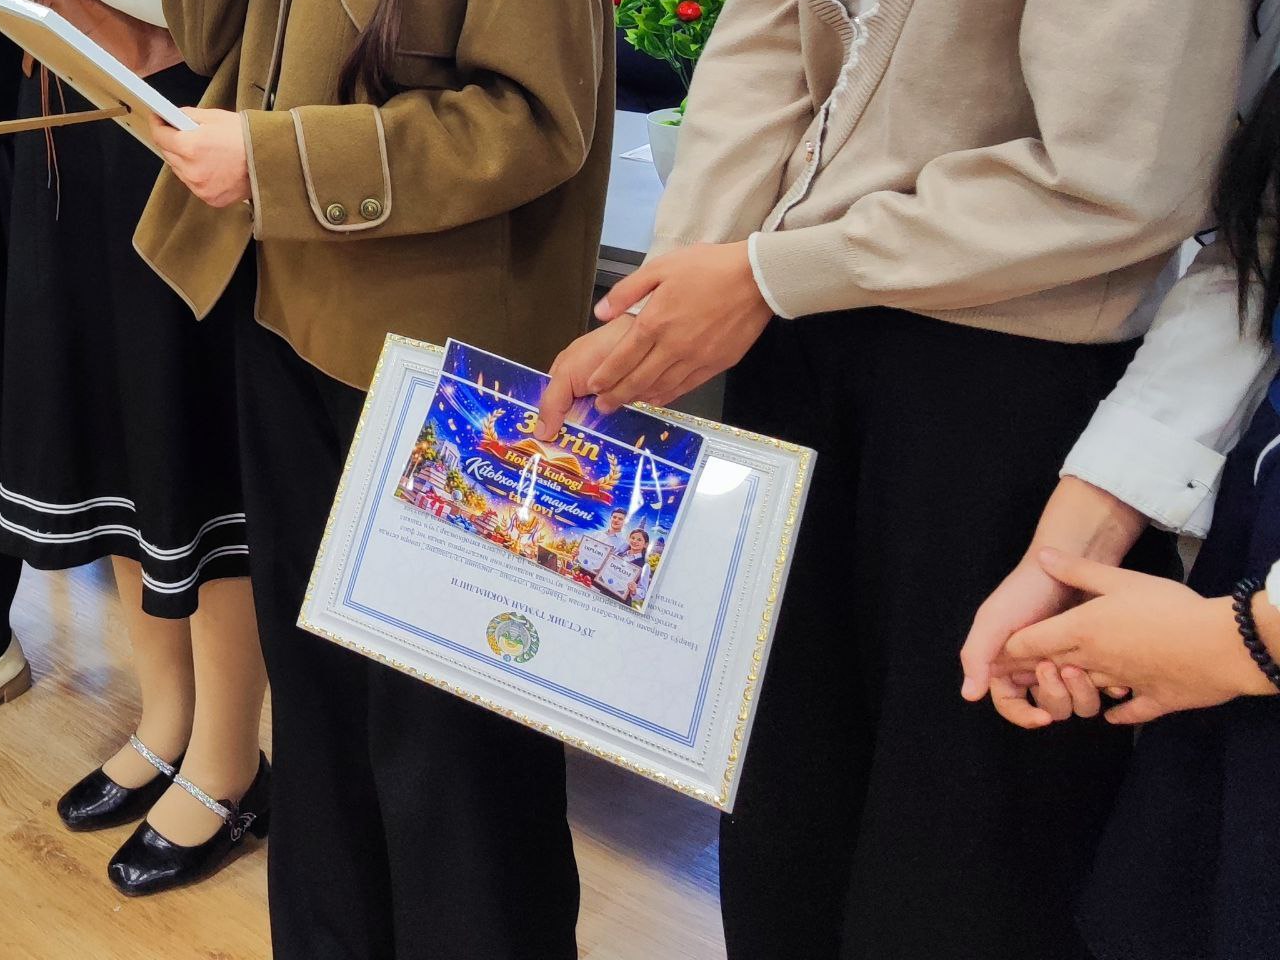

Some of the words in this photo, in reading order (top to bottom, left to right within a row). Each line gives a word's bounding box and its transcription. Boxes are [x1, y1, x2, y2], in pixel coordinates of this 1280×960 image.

[544, 465, 583, 490] kubogi
[541, 493, 594, 520] maydoni
[510, 598, 547, 621] ТУМАН
